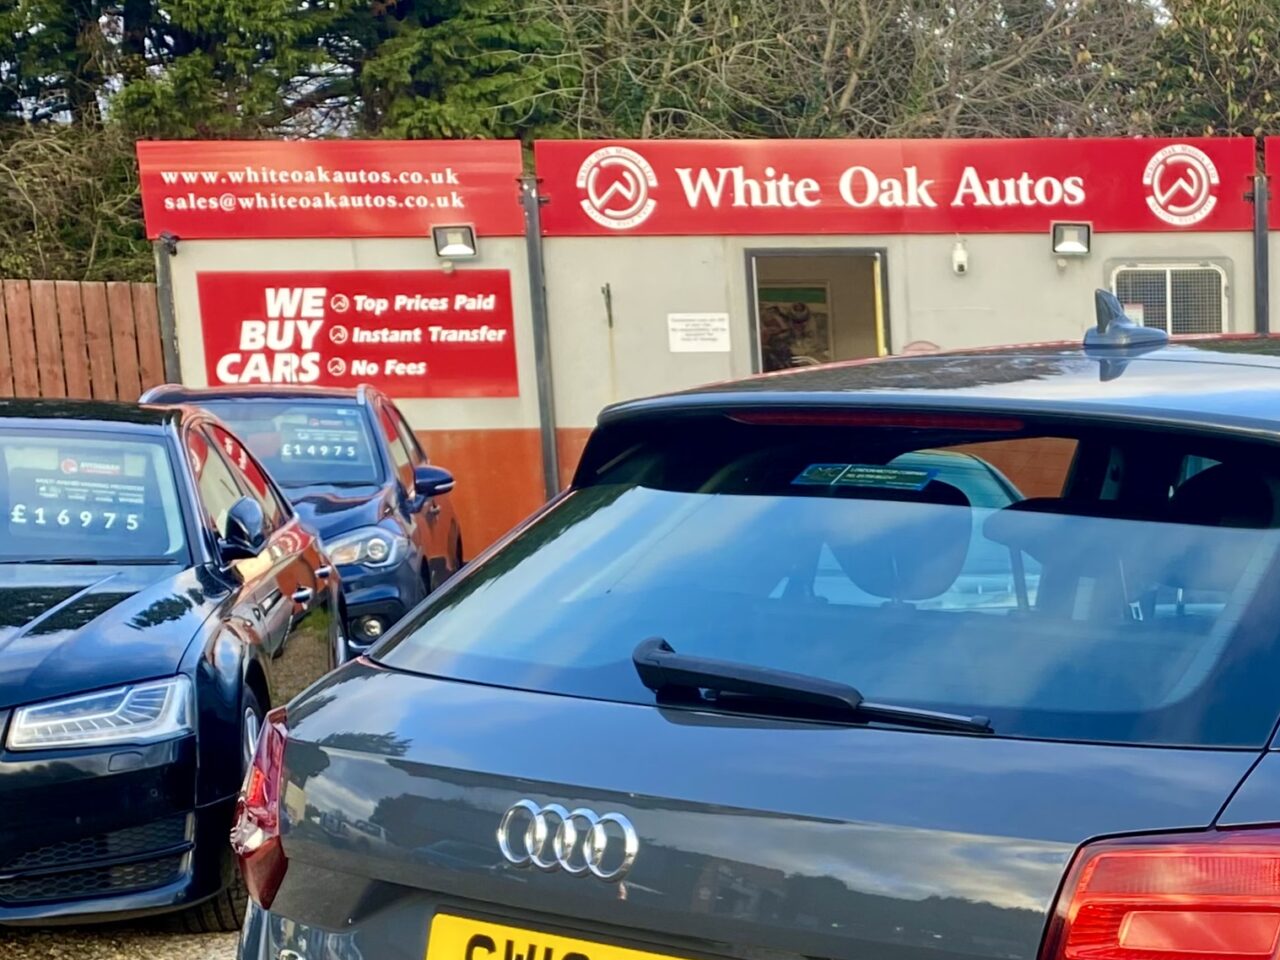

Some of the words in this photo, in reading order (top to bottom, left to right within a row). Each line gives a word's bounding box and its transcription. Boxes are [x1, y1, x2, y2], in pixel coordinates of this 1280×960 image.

[160, 166, 460, 185] www.whiteoakautos.co.uk
[675, 165, 821, 208] White
[838, 165, 938, 208] Oak
[950, 166, 1086, 207] Autos
[164, 192, 465, 212] sales@whiteoakautos.co.uk
[265, 287, 326, 318] WE
[353, 295, 388, 315] Top
[394, 294, 449, 311] Prices
[454, 294, 496, 311] Paid
[239, 320, 324, 350] BUY
[352, 326, 422, 343] Instant
[428, 325, 507, 342] Transfer
[216, 352, 321, 383] CARS
[351, 360, 379, 376] No
[385, 359, 427, 376] Fees
[281, 443, 356, 457] £14975
[11, 504, 139, 530] £16975
